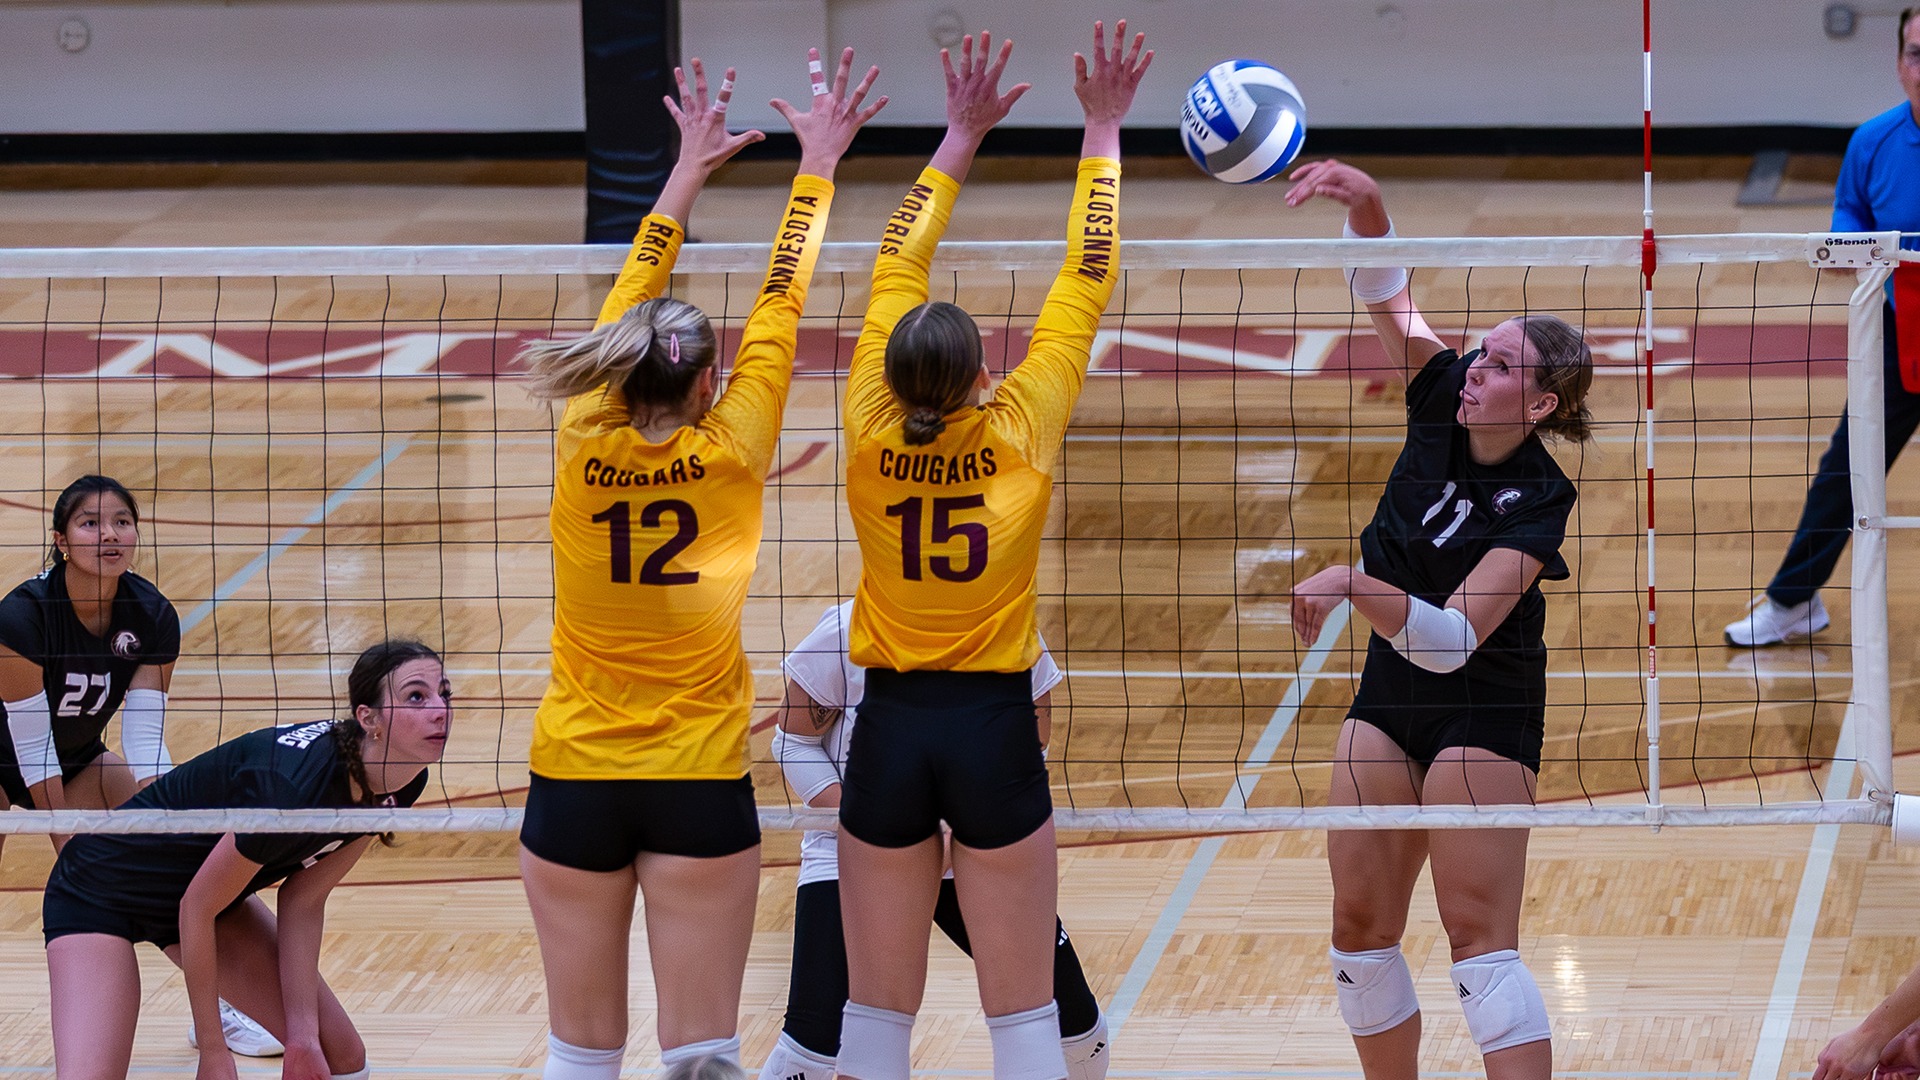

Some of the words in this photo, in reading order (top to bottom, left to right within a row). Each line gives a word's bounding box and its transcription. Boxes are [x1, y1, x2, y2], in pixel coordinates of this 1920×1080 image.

[880, 183, 934, 256] MORRIS
[1833, 237, 1877, 246] Senoh
[584, 453, 706, 487] COUGARS
[879, 447, 998, 486] COUGARS
[592, 498, 700, 586] 12
[885, 492, 989, 583] 15
[57, 672, 111, 717] 27
